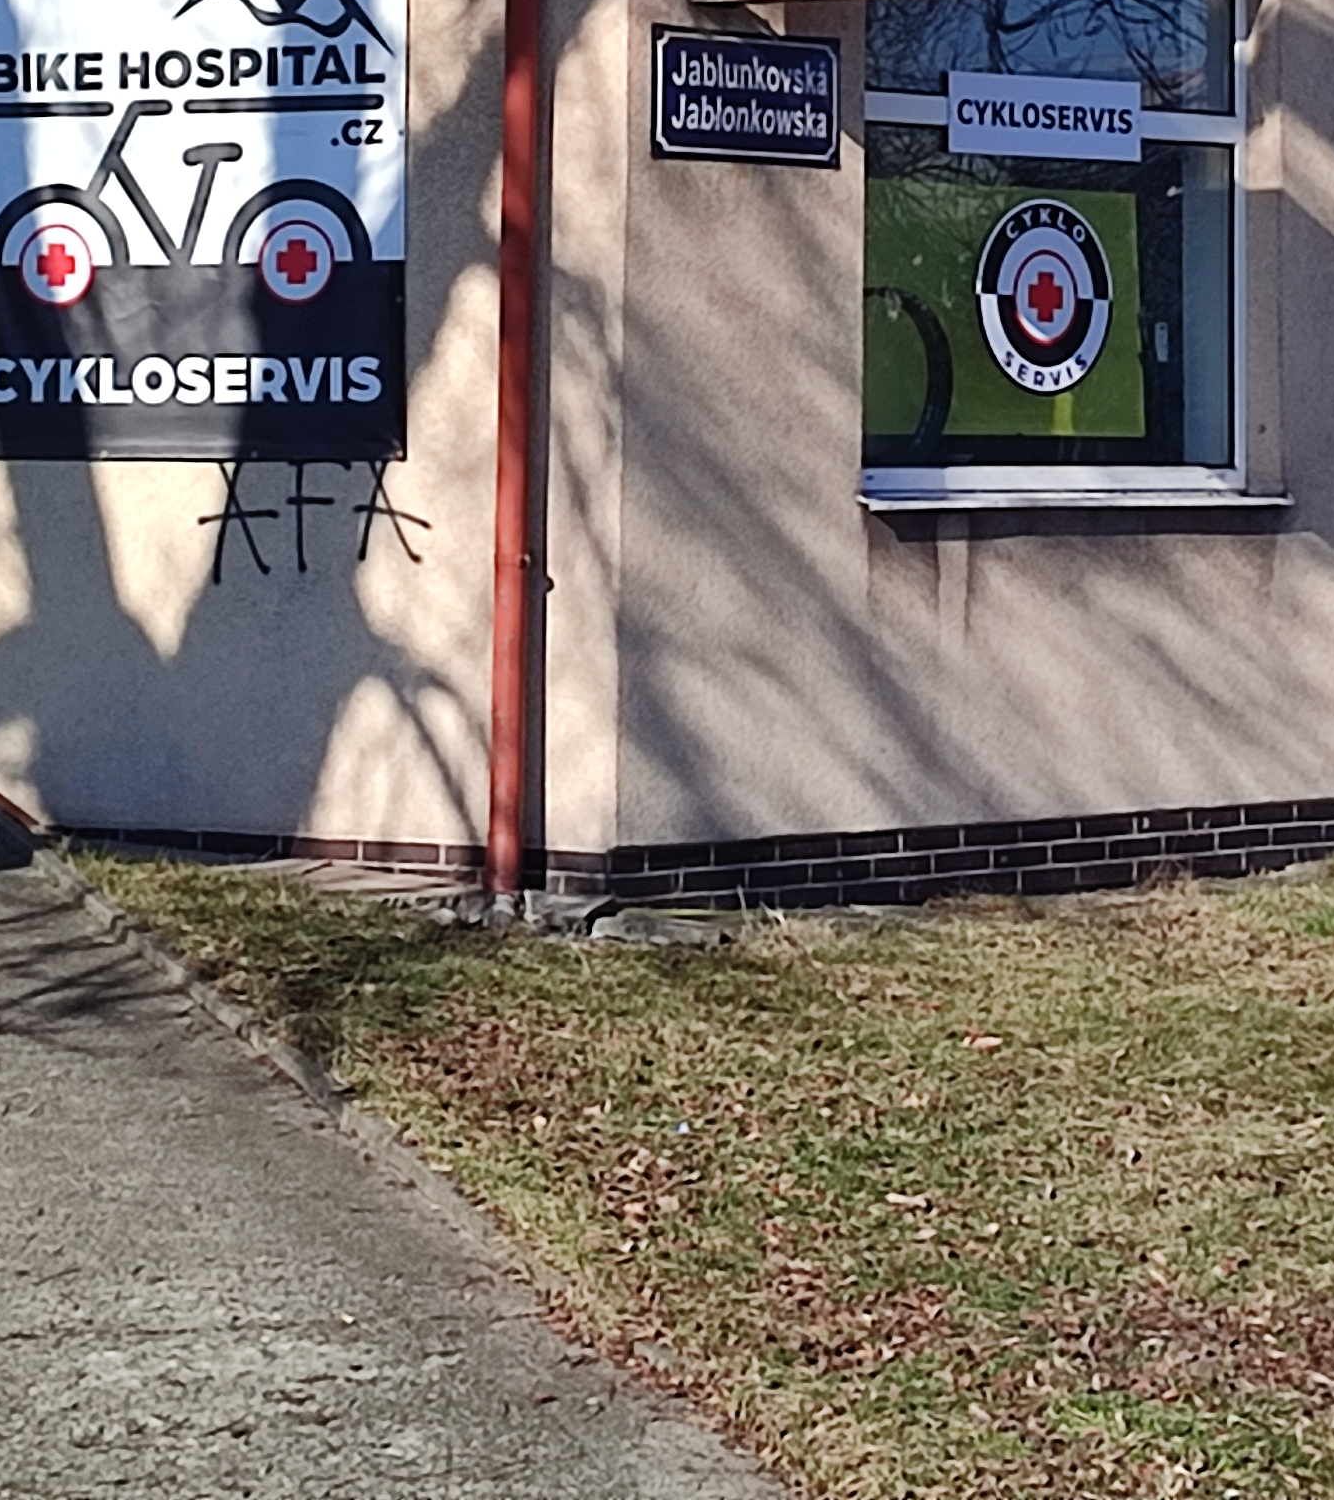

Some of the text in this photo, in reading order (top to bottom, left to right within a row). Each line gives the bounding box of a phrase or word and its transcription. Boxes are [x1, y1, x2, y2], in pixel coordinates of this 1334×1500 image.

[119, 43, 387, 90] HOSPITAL
[670, 50, 828, 96] Jablunkovská
[330, 117, 385, 148] .CZ
[670, 93, 828, 139] Jabłonkowska
[957, 98, 1134, 135] CYKLOSERVIS
[1004, 206, 1087, 244] CYKLO
[1002, 350, 1089, 387] SERVIS
